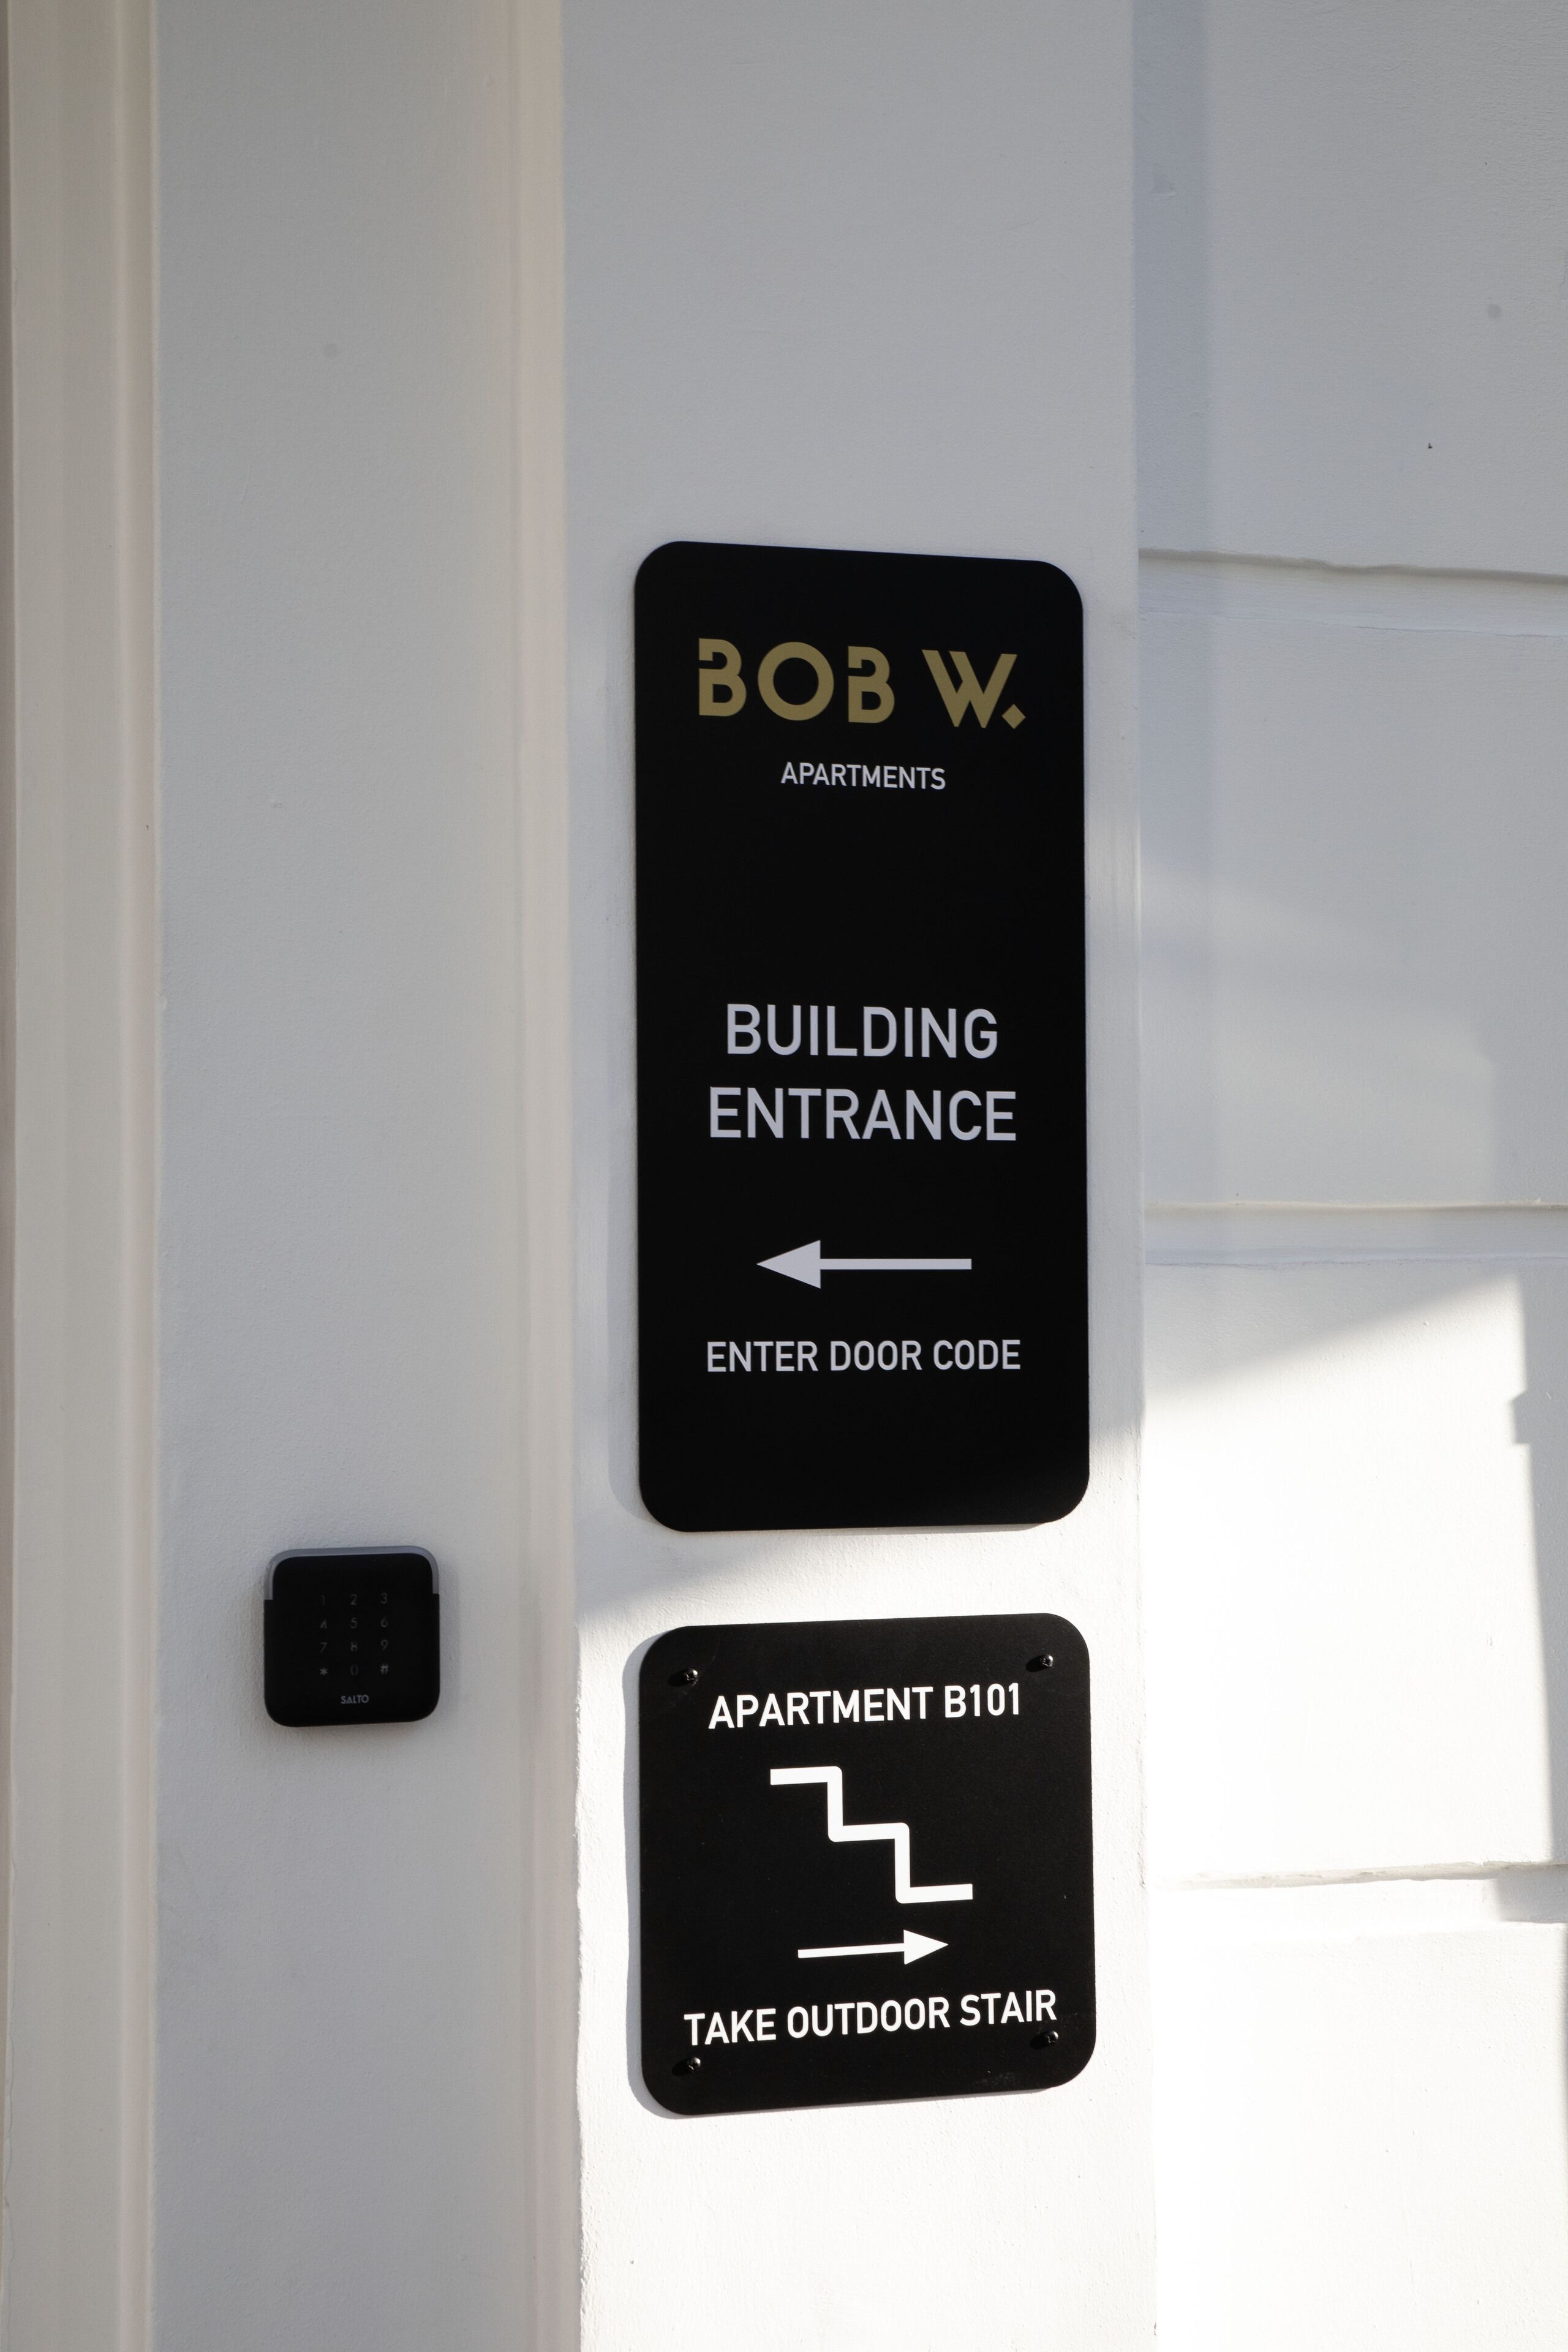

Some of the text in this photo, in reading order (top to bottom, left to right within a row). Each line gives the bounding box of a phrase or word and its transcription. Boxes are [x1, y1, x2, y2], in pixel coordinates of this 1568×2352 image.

[699, 638, 1025, 728] BOB W.
[781, 762, 946, 790] APARTMENTS
[728, 1004, 997, 1058] BUILDING
[710, 1087, 1016, 1140] ENTRANCE
[707, 1340, 1020, 1372] ENTER DOOR CODE
[320, 1592, 388, 1606] 1 2 3
[320, 1616, 388, 1629] 4 5 6
[320, 1639, 389, 1653] 7 8 9
[350, 1665, 359, 1676] 0
[340, 1694, 370, 1705] SALTO
[709, 1683, 1019, 1729] APARTMENT B101
[684, 1989, 1057, 2046] TAKE OUTDOOR STAIR
